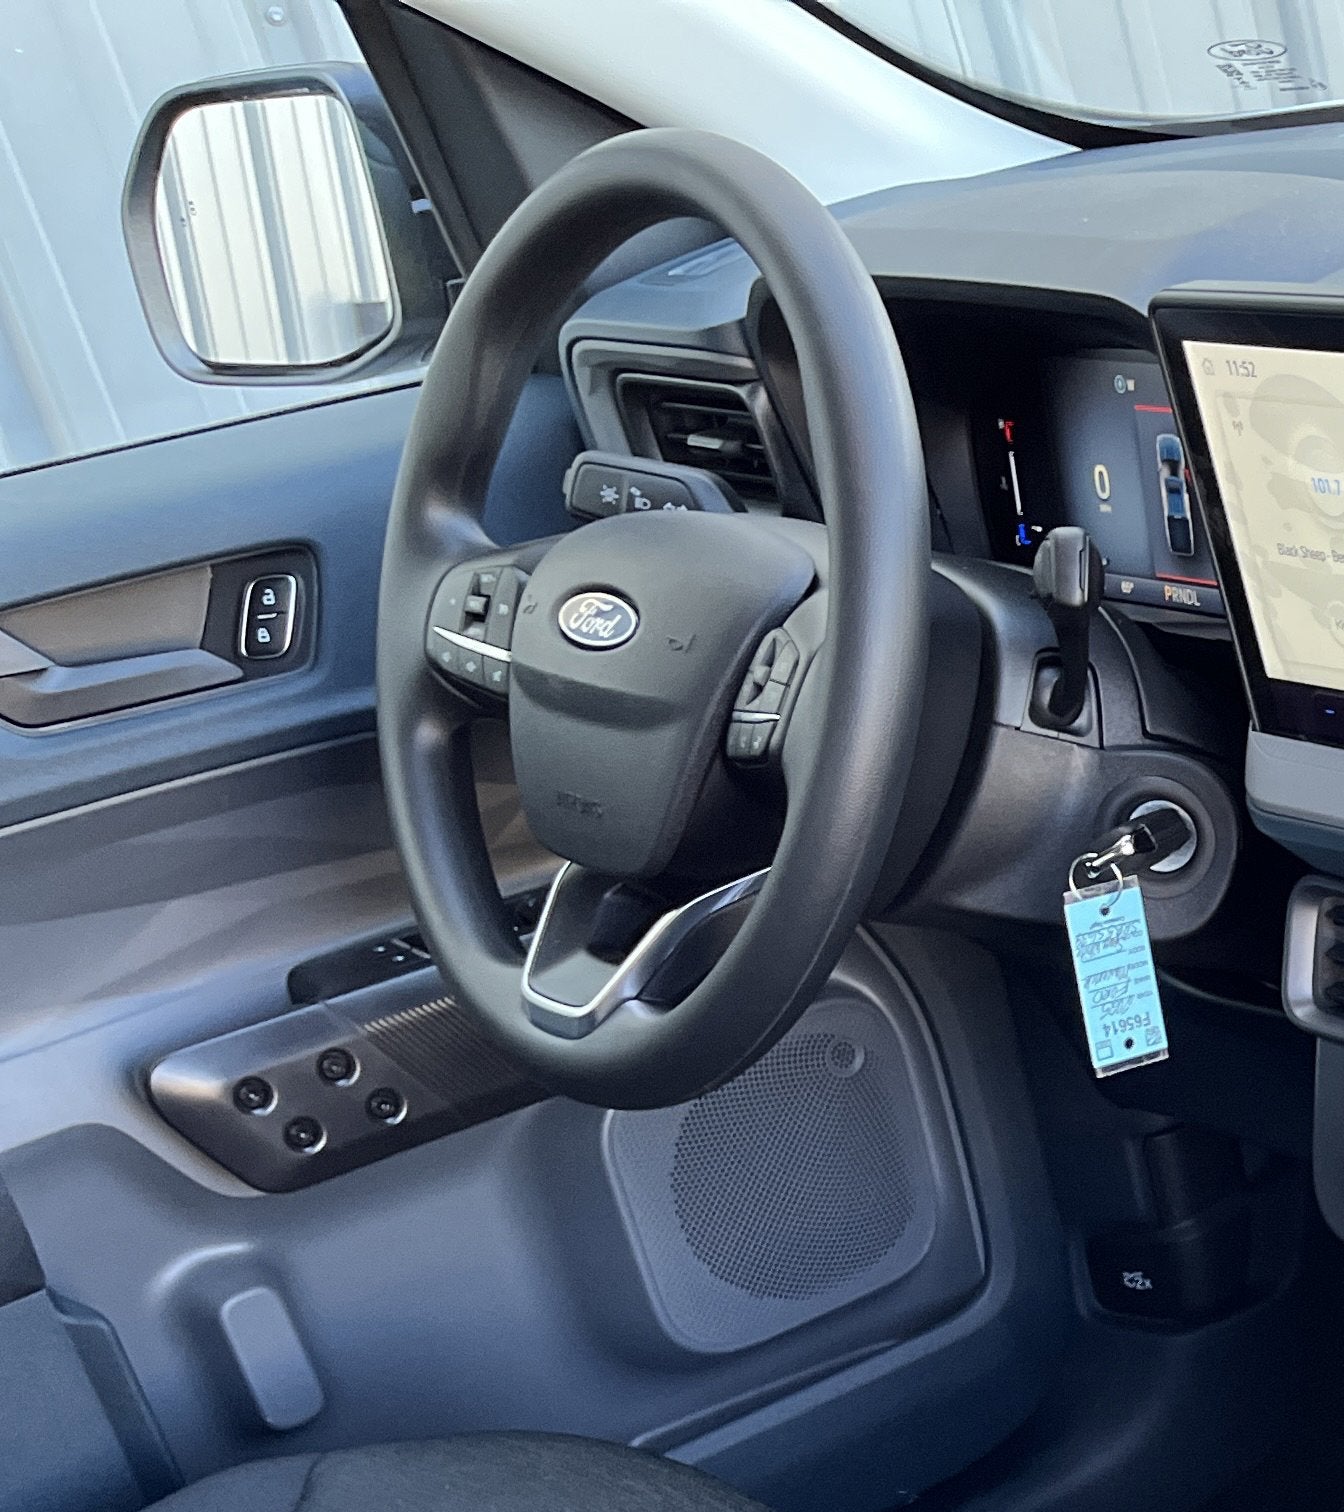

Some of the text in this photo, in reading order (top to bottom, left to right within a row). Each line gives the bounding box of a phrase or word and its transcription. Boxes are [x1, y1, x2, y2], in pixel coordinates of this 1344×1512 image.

[1094, 464, 1110, 500] 0
[1311, 477, 1341, 496] 101.7
[568, 597, 623, 638] Ford
[1102, 1012, 1151, 1038] F65614
